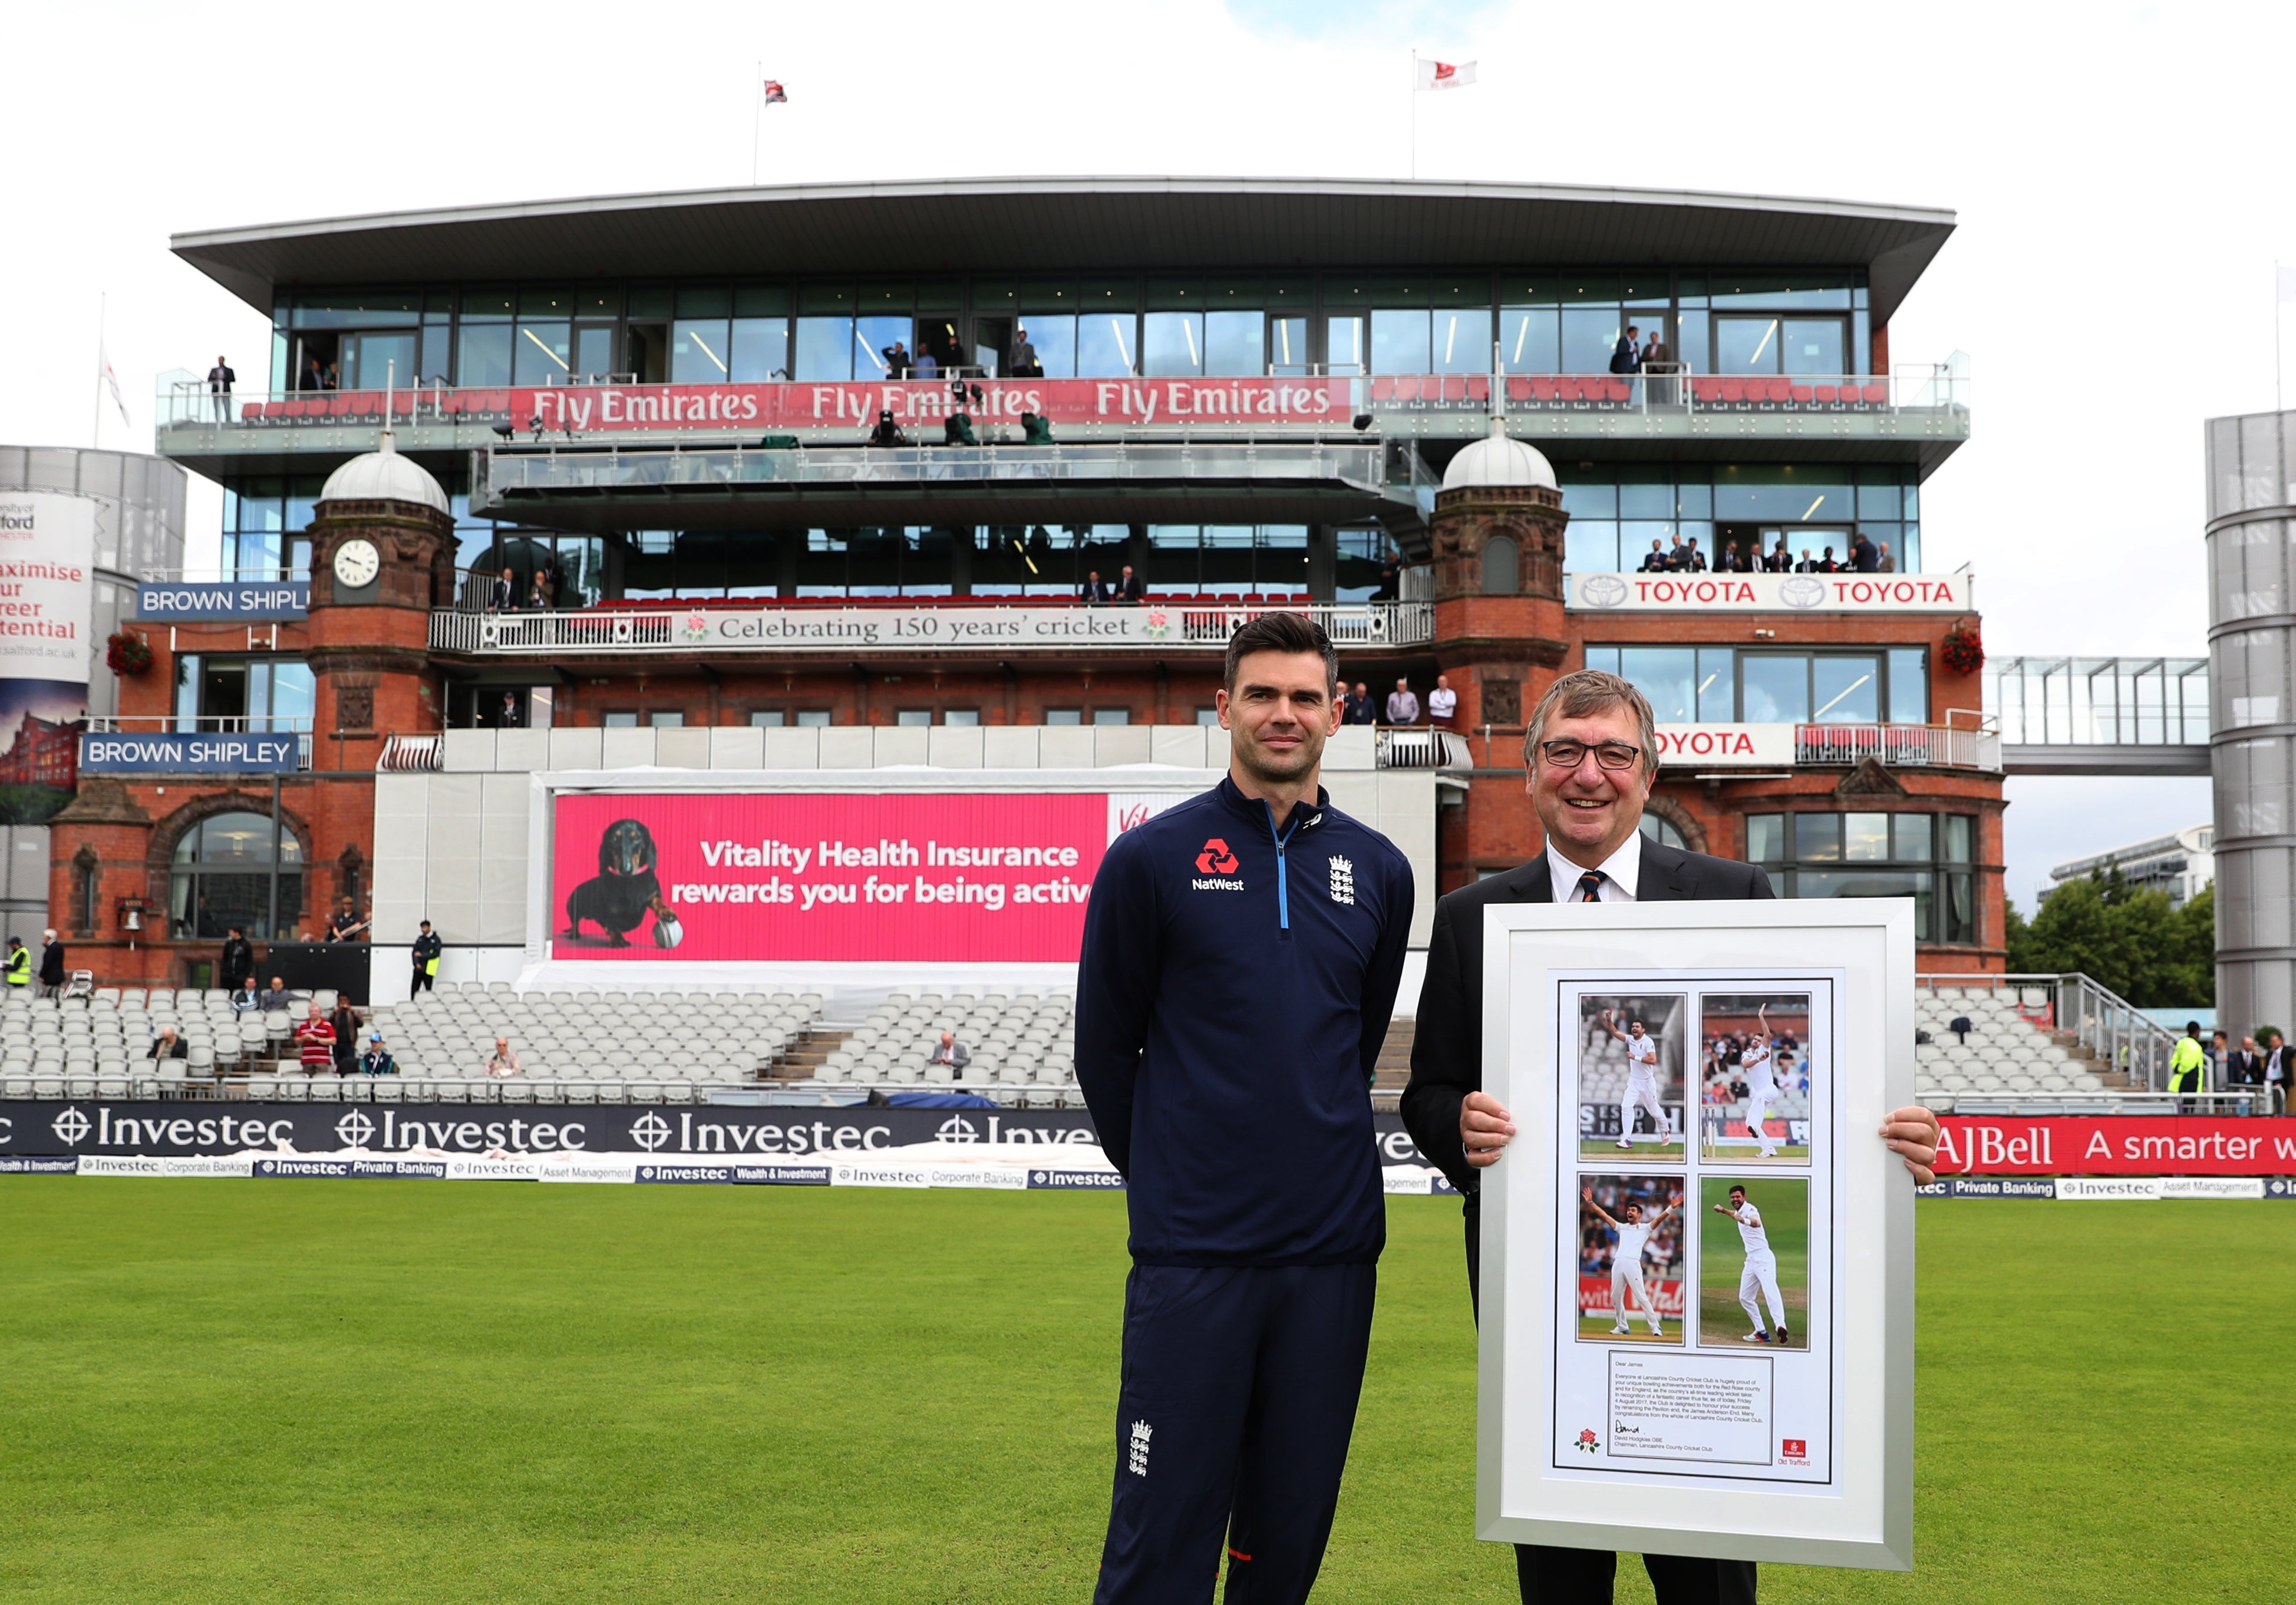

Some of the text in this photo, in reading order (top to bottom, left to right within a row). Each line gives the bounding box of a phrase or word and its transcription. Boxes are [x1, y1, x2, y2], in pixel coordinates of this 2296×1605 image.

[533, 388, 758, 430] Fly Emirates
[813, 383, 1041, 425] Fly Emiates
[1097, 381, 1330, 422] Fly Emirates
[0, 514, 34, 530] ford
[0, 583, 23, 597] ur
[1635, 581, 1756, 602] TOYOTA
[1833, 582, 1954, 602] TOYOTA
[0, 602, 42, 617] reer
[143, 590, 310, 611] BROWN SHIPL
[0, 620, 75, 639] tential
[719, 617, 879, 643] Celebrating
[893, 617, 938, 637] 150
[1035, 615, 1130, 636] cricket
[89, 742, 290, 763] BROWN SHIPLEY
[1654, 732, 1754, 755] OYOTA
[700, 839, 1079, 874] Vitality Health Insurance
[671, 876, 794, 903] rewards
[800, 884, 857, 911] you
[863, 875, 909, 903] for
[916, 876, 1005, 911] being
[1192, 879, 1244, 891] NatWest
[98, 1108, 293, 1145] Investec
[383, 1111, 586, 1150] Investec
[679, 1113, 890, 1151] Investec
[2084, 1130, 2113, 1160] A
[2124, 1131, 2262, 1160] smarter
[24, 1160, 30, 1171] &
[31, 1160, 77, 1171] Investment
[96, 1158, 250, 1175] Investec Corporate Banking
[276, 1160, 444, 1177] Investec Private Banking
[467, 1163, 631, 1181] Investec Asset Management
[656, 1167, 827, 1180] Investec Wealth & Investment
[853, 1170, 1024, 1185] Investec Corporate Banking
[1048, 1171, 1122, 1186] Investec
[1955, 1181, 2000, 1194] Private
[2003, 1181, 2053, 1197] Banking
[2080, 1181, 2154, 1194] Investec
[1619, 1397, 1635, 1405] August
[1674, 1400, 1695, 1408] delighted
[1621, 1391, 1645, 1399] recognition
